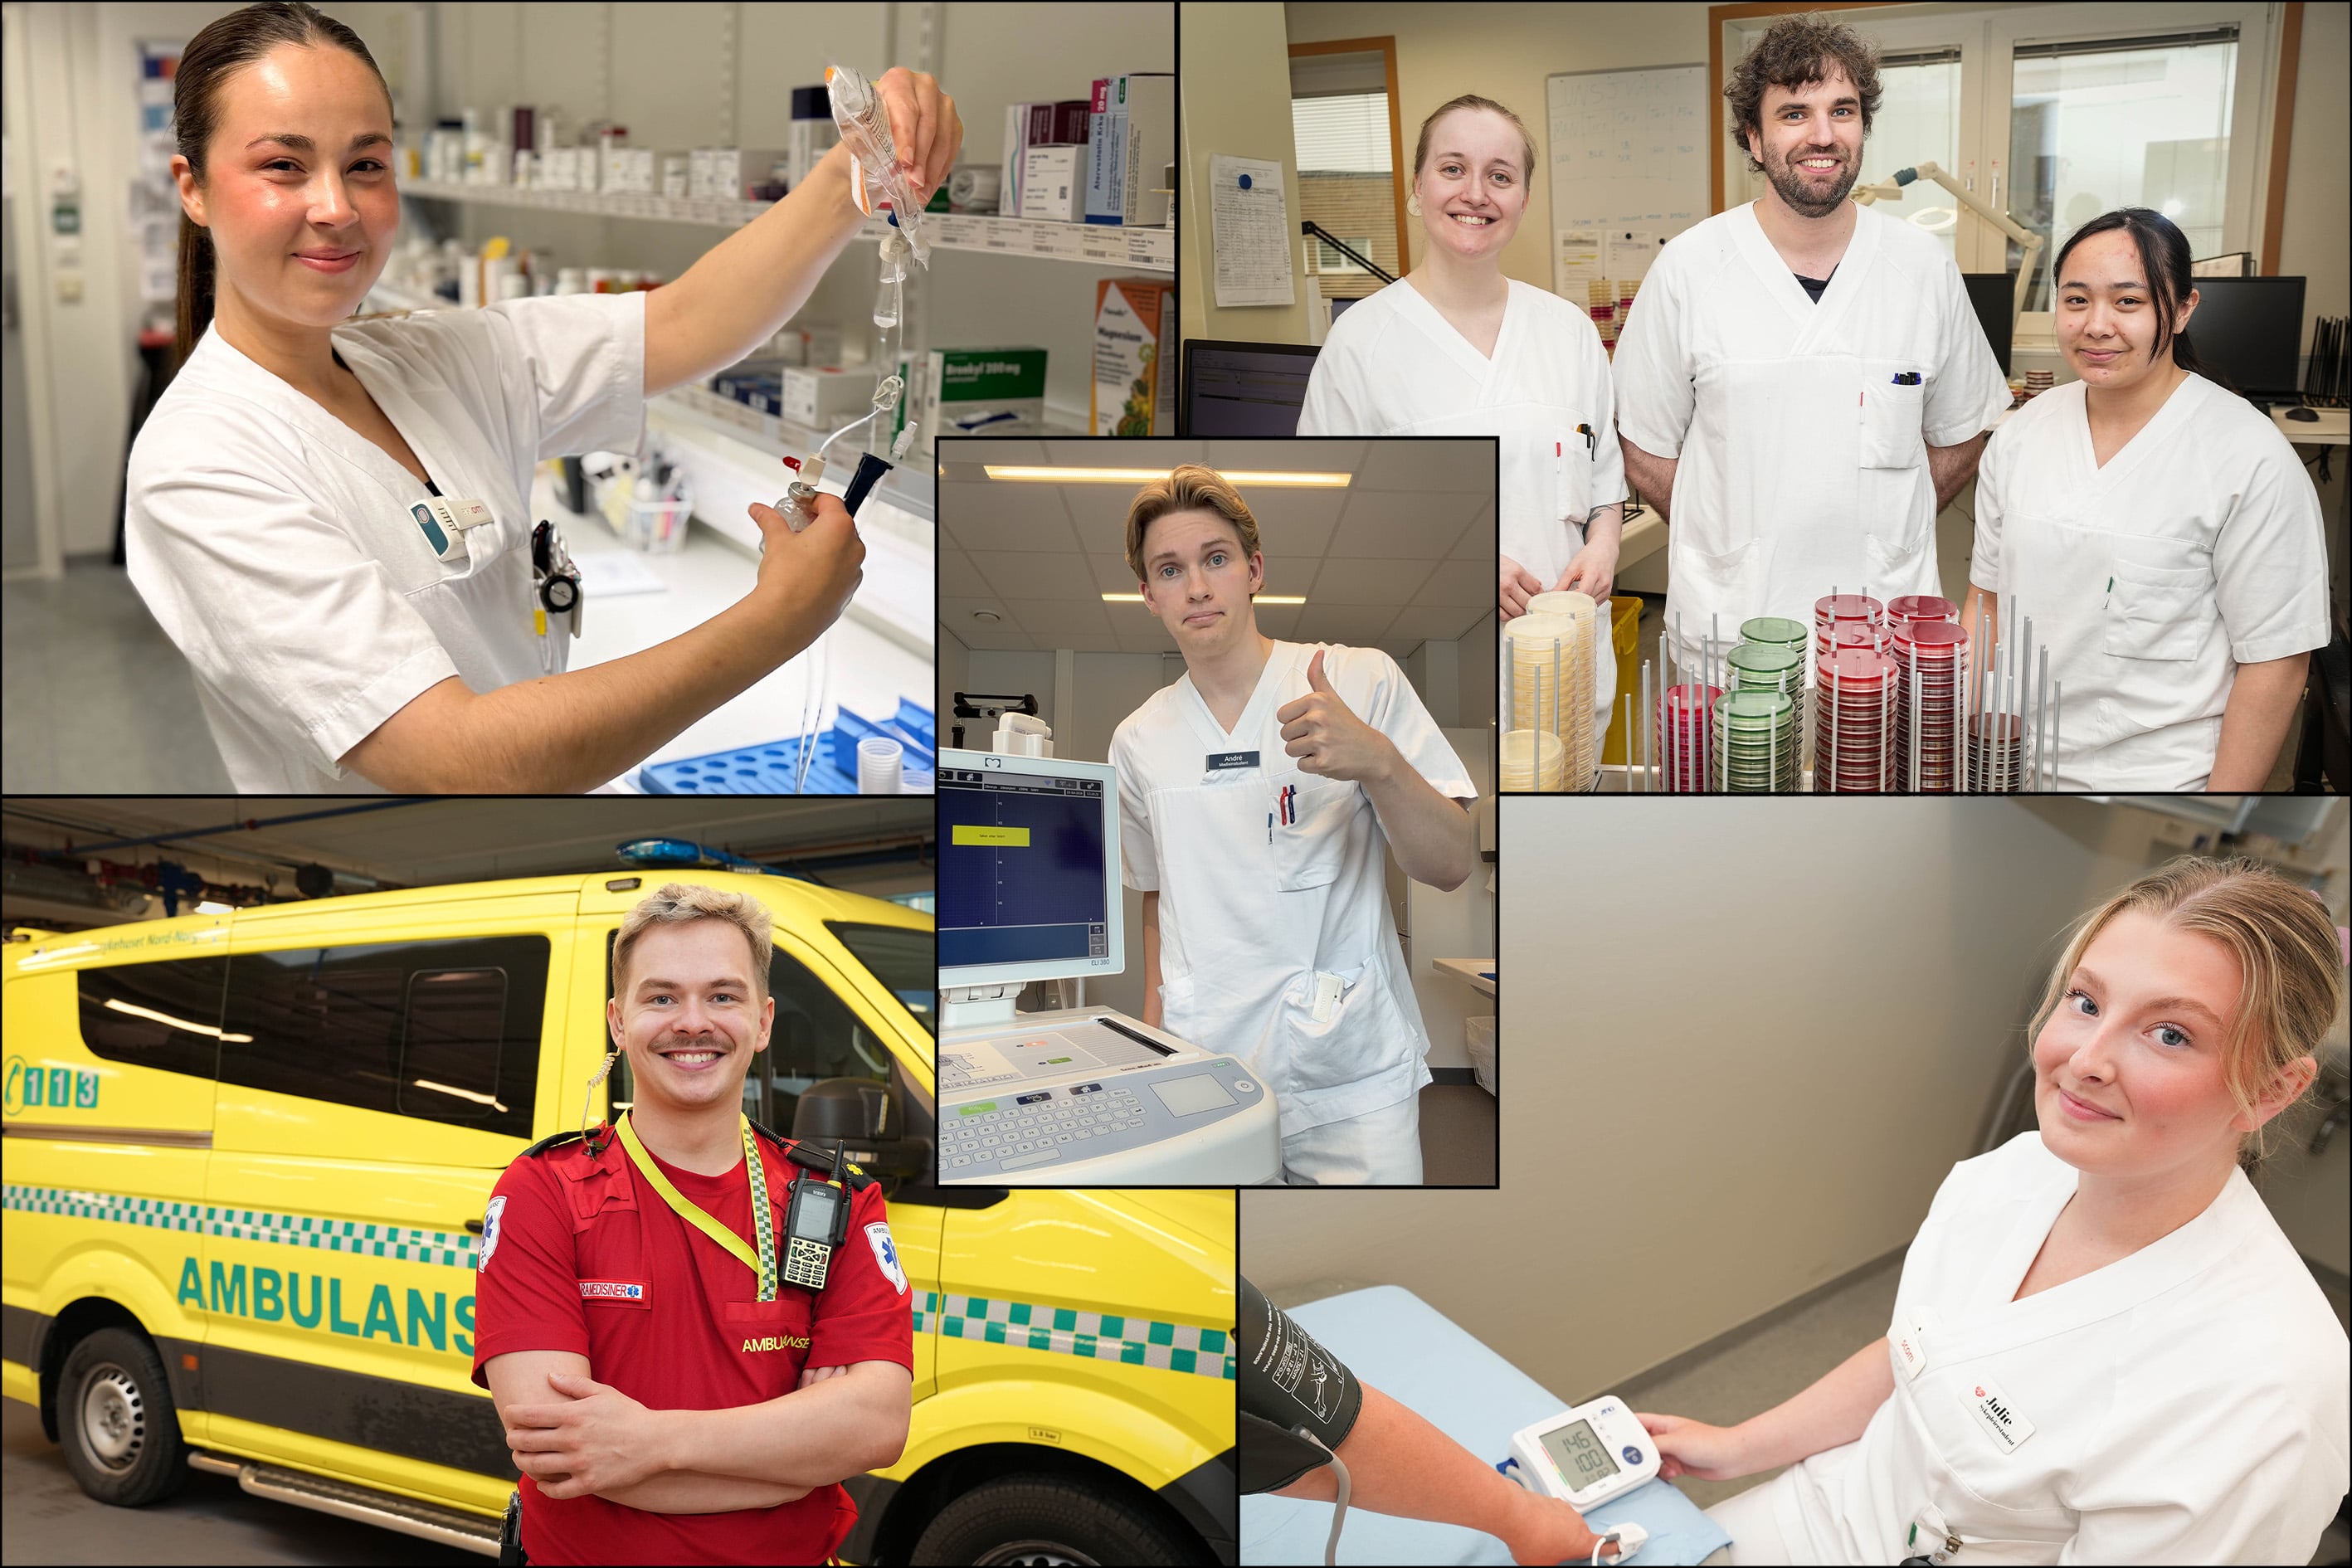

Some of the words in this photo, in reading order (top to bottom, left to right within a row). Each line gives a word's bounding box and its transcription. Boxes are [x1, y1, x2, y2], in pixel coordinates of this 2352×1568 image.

[1099, 86, 1107, 100] mg
[1098, 100, 1105, 111] 20
[1985, 1397, 2012, 1427] Julie
[1979, 1404, 2015, 1446] Sykepleierstudent
[1562, 1430, 1591, 1454] 146
[1575, 1449, 1604, 1473] 100
